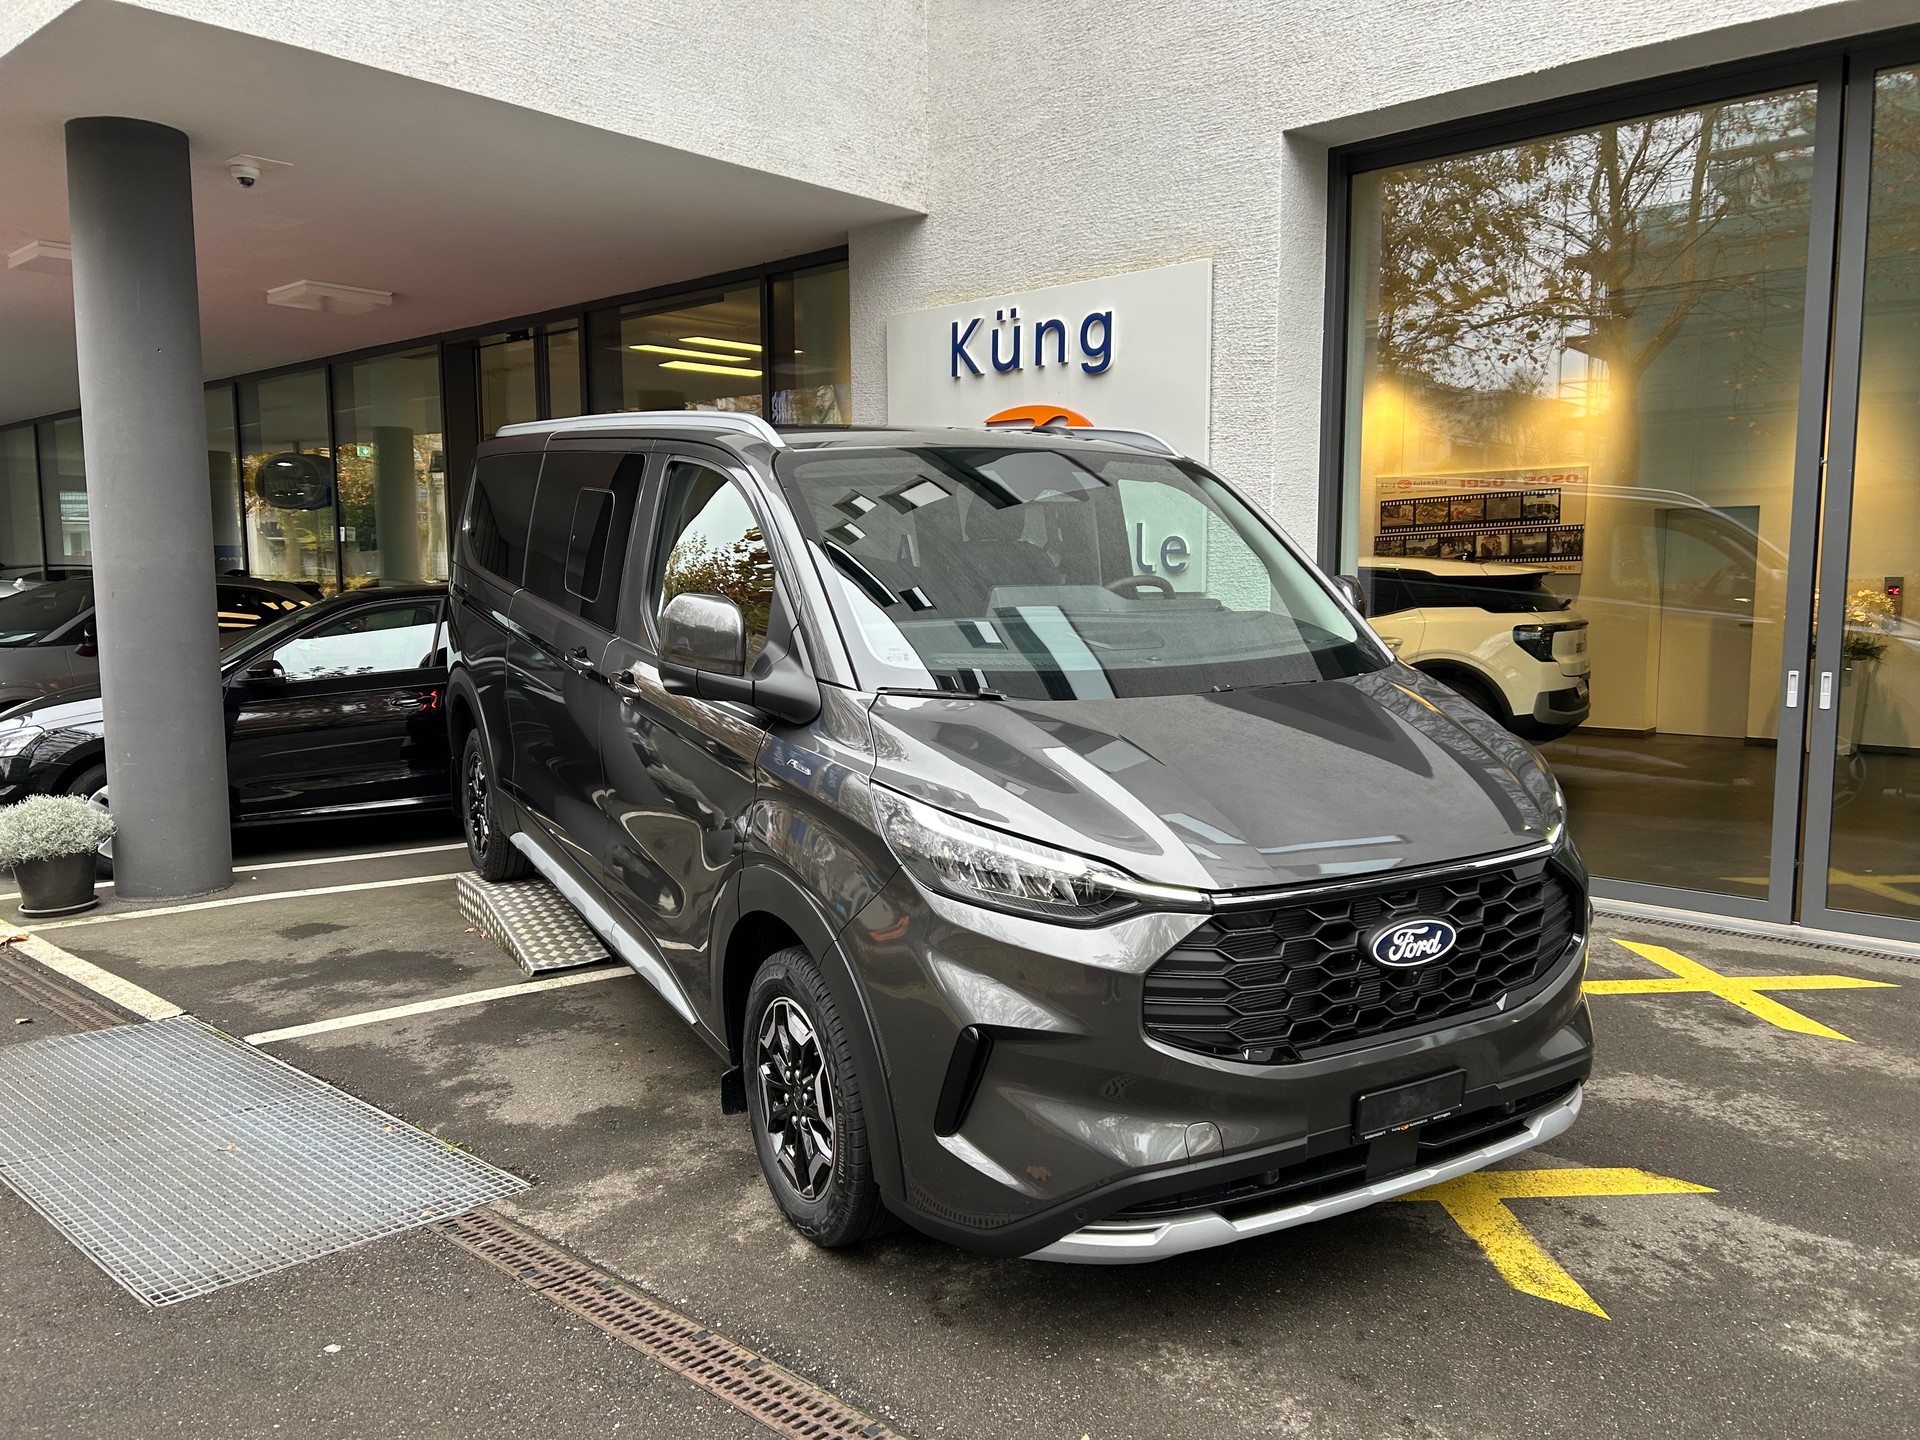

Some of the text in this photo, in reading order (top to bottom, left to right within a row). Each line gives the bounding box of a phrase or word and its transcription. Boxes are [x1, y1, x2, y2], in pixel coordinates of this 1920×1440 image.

[951, 307, 1115, 377] Küng
[1460, 477, 1505, 488] 1950
[1522, 473, 1579, 486] 2020
[1388, 925, 1443, 962] Ford
[836, 1112, 846, 1178] Continental
